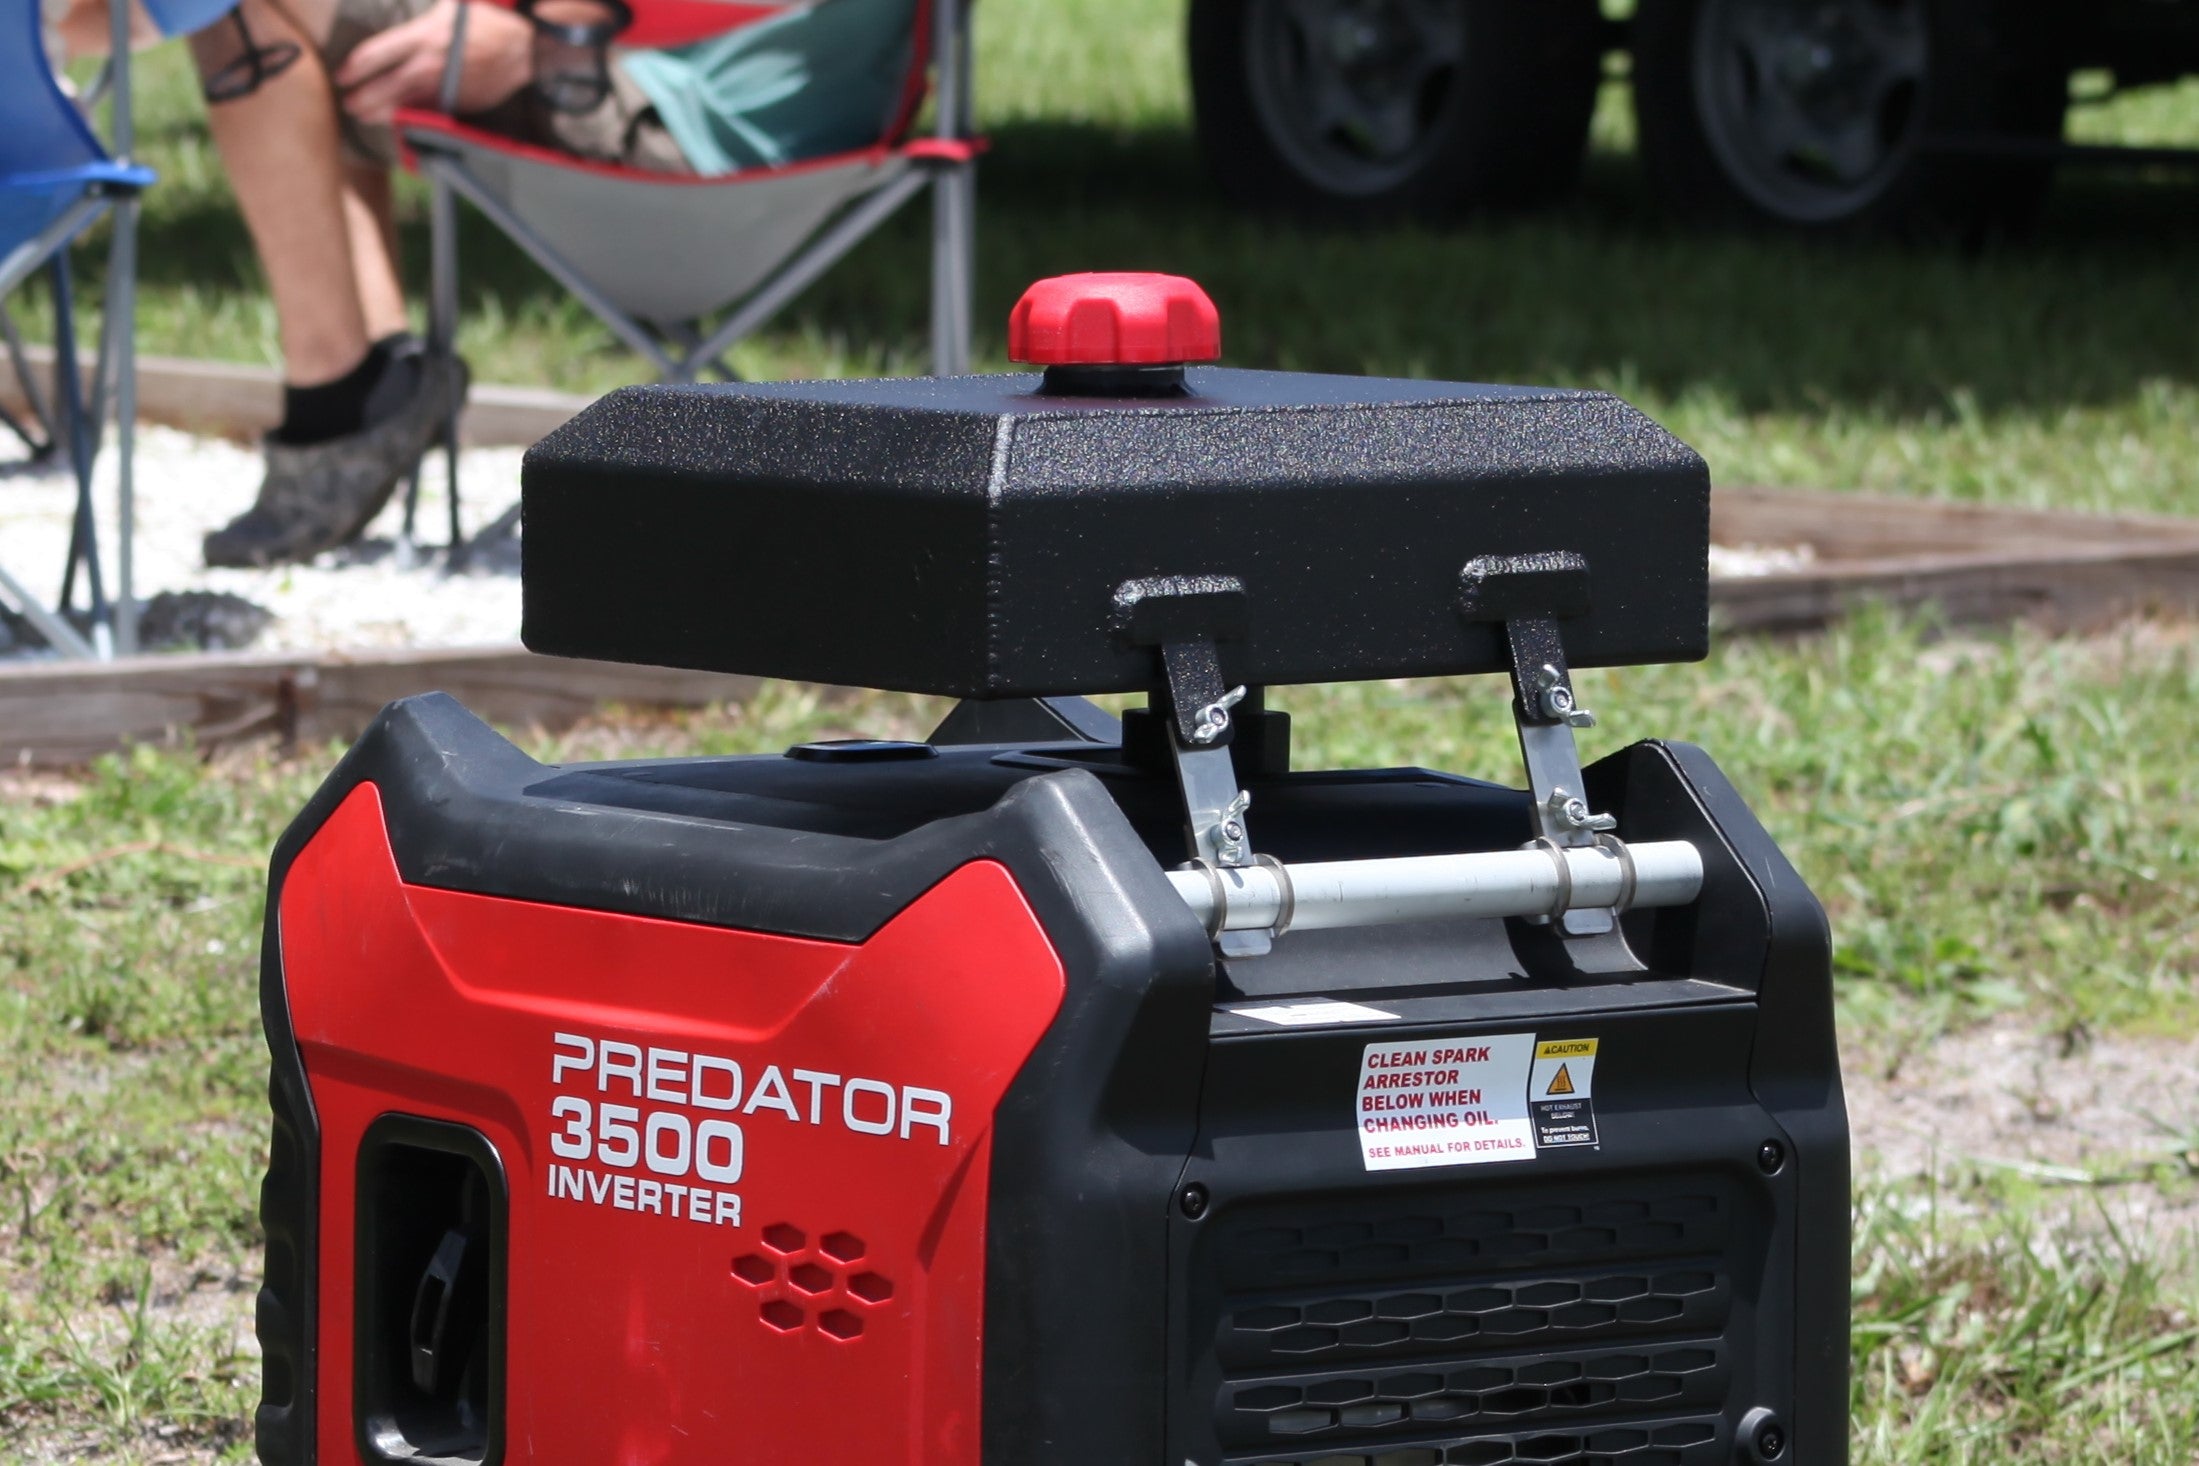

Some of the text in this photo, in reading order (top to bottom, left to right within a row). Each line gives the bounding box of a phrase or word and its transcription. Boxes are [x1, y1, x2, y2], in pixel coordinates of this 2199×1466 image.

[1367, 1046, 1491, 1069] CLEAN SPARK
[1550, 1043, 1590, 1053] CAUTION
[552, 1032, 951, 1146] PREDATOR
[1363, 1069, 1460, 1090] ARRESTOR
[1362, 1089, 1482, 1112] BELOW WHEN
[1363, 1110, 1499, 1134] CHANGING OIL.
[550, 1096, 744, 1184] 3500
[1368, 1137, 1526, 1159] SEE MANUAL FOR DETAILS.
[547, 1164, 741, 1228] INVERTER
